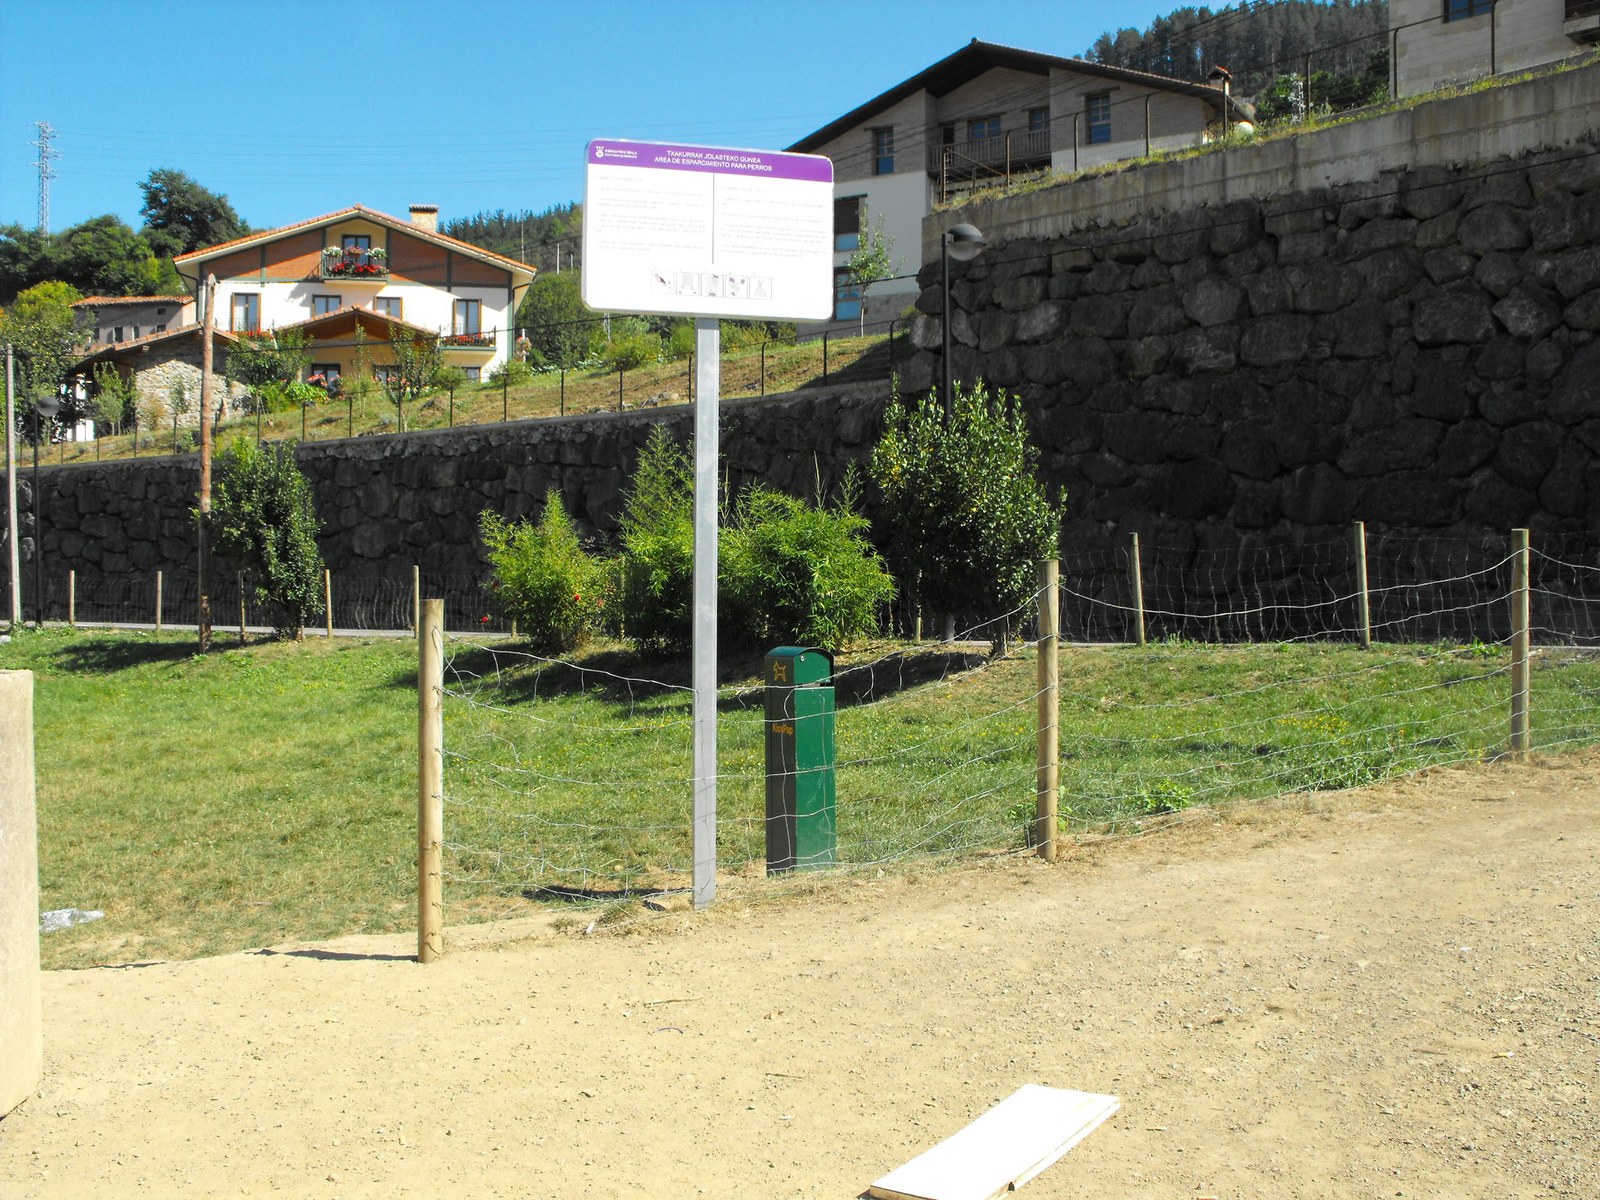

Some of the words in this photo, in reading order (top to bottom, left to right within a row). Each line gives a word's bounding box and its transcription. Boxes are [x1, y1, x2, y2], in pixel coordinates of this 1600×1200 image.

[654, 156, 672, 164] AREA
[682, 159, 730, 168] ESPARCIMIENTO
[666, 150, 703, 159] TXAKURRAK
[704, 153, 739, 162] JOLASTEKO
[740, 156, 761, 164] GUNEA
